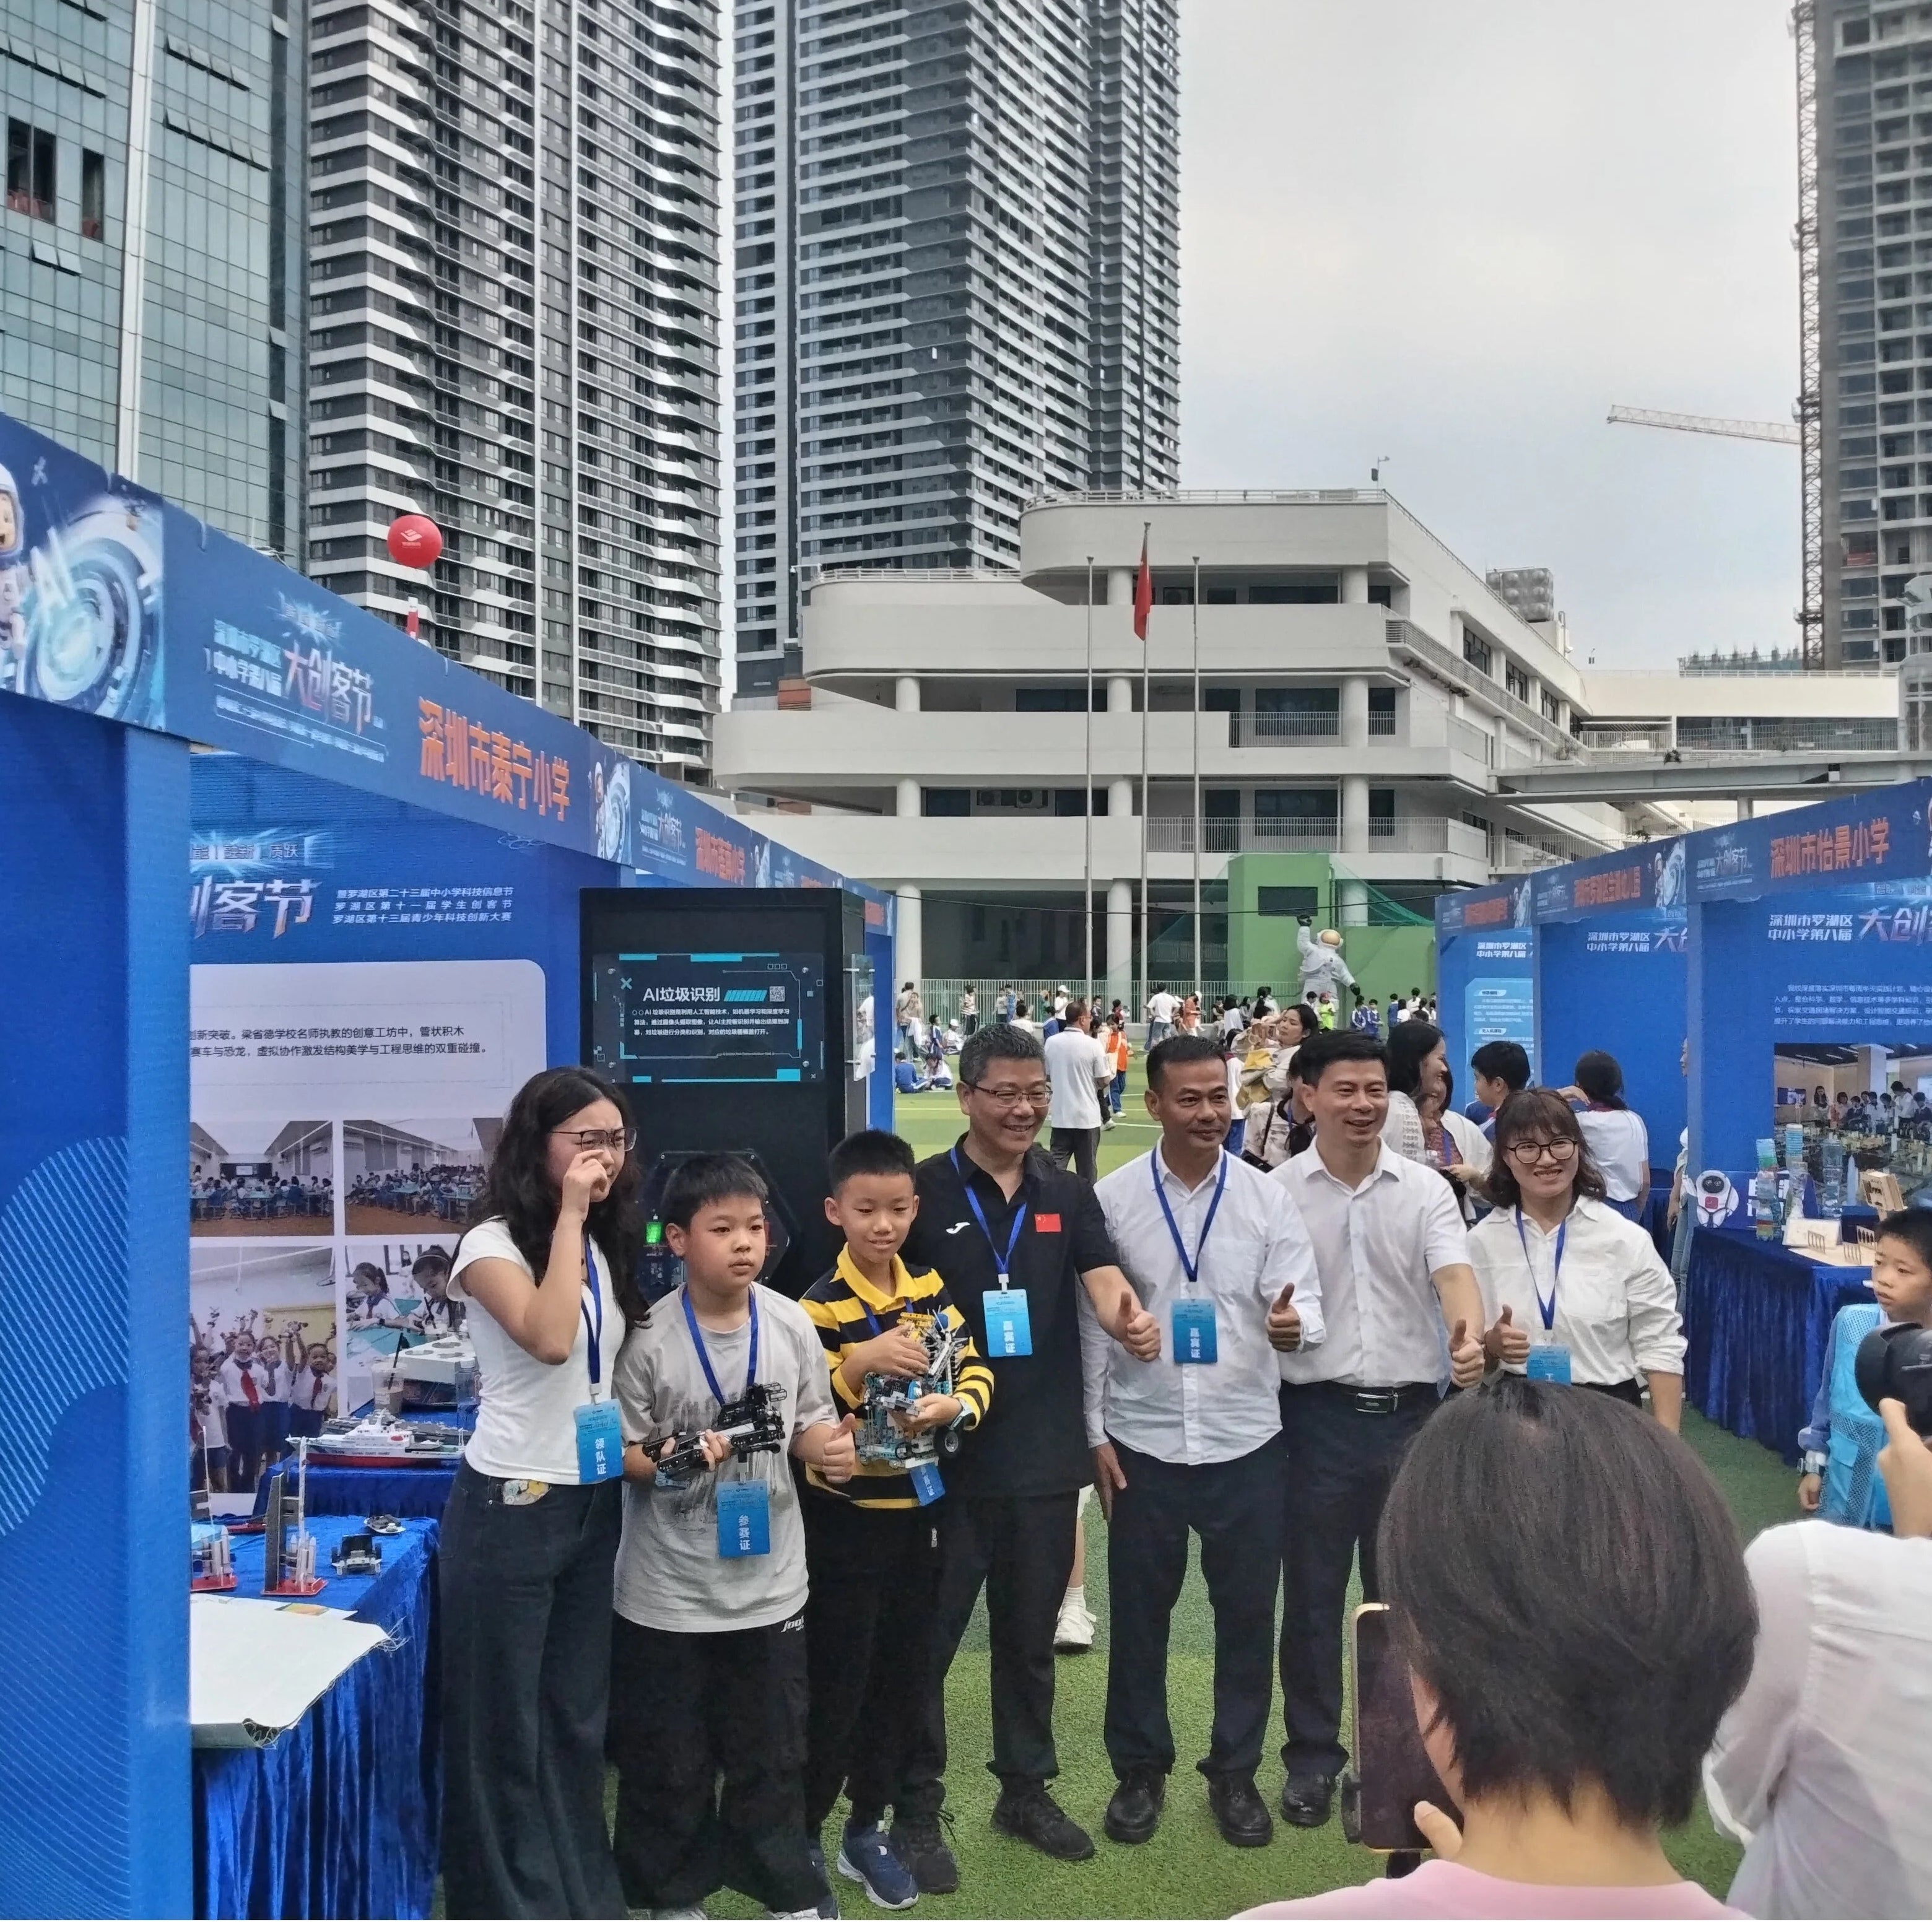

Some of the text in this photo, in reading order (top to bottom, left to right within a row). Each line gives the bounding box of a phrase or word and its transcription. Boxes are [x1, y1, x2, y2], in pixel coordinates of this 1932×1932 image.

[284, 640, 374, 736] 大创客节
[419, 696, 570, 822] 深圳市泰宁小学
[1770, 817, 1889, 879] 深圳市怡景小学
[1769, 914, 1853, 927] 深圳市罗湖区
[1858, 905, 1932, 947] 大创
[1586, 942, 1650, 952] 中小学第八届
[1588, 931, 1650, 942] 深圳市罗湖区
[1768, 929, 1853, 941] 中小学第八届
[643, 986, 720, 1002] AI垃圾识别
[595, 1437, 606, 1475] 领队证
